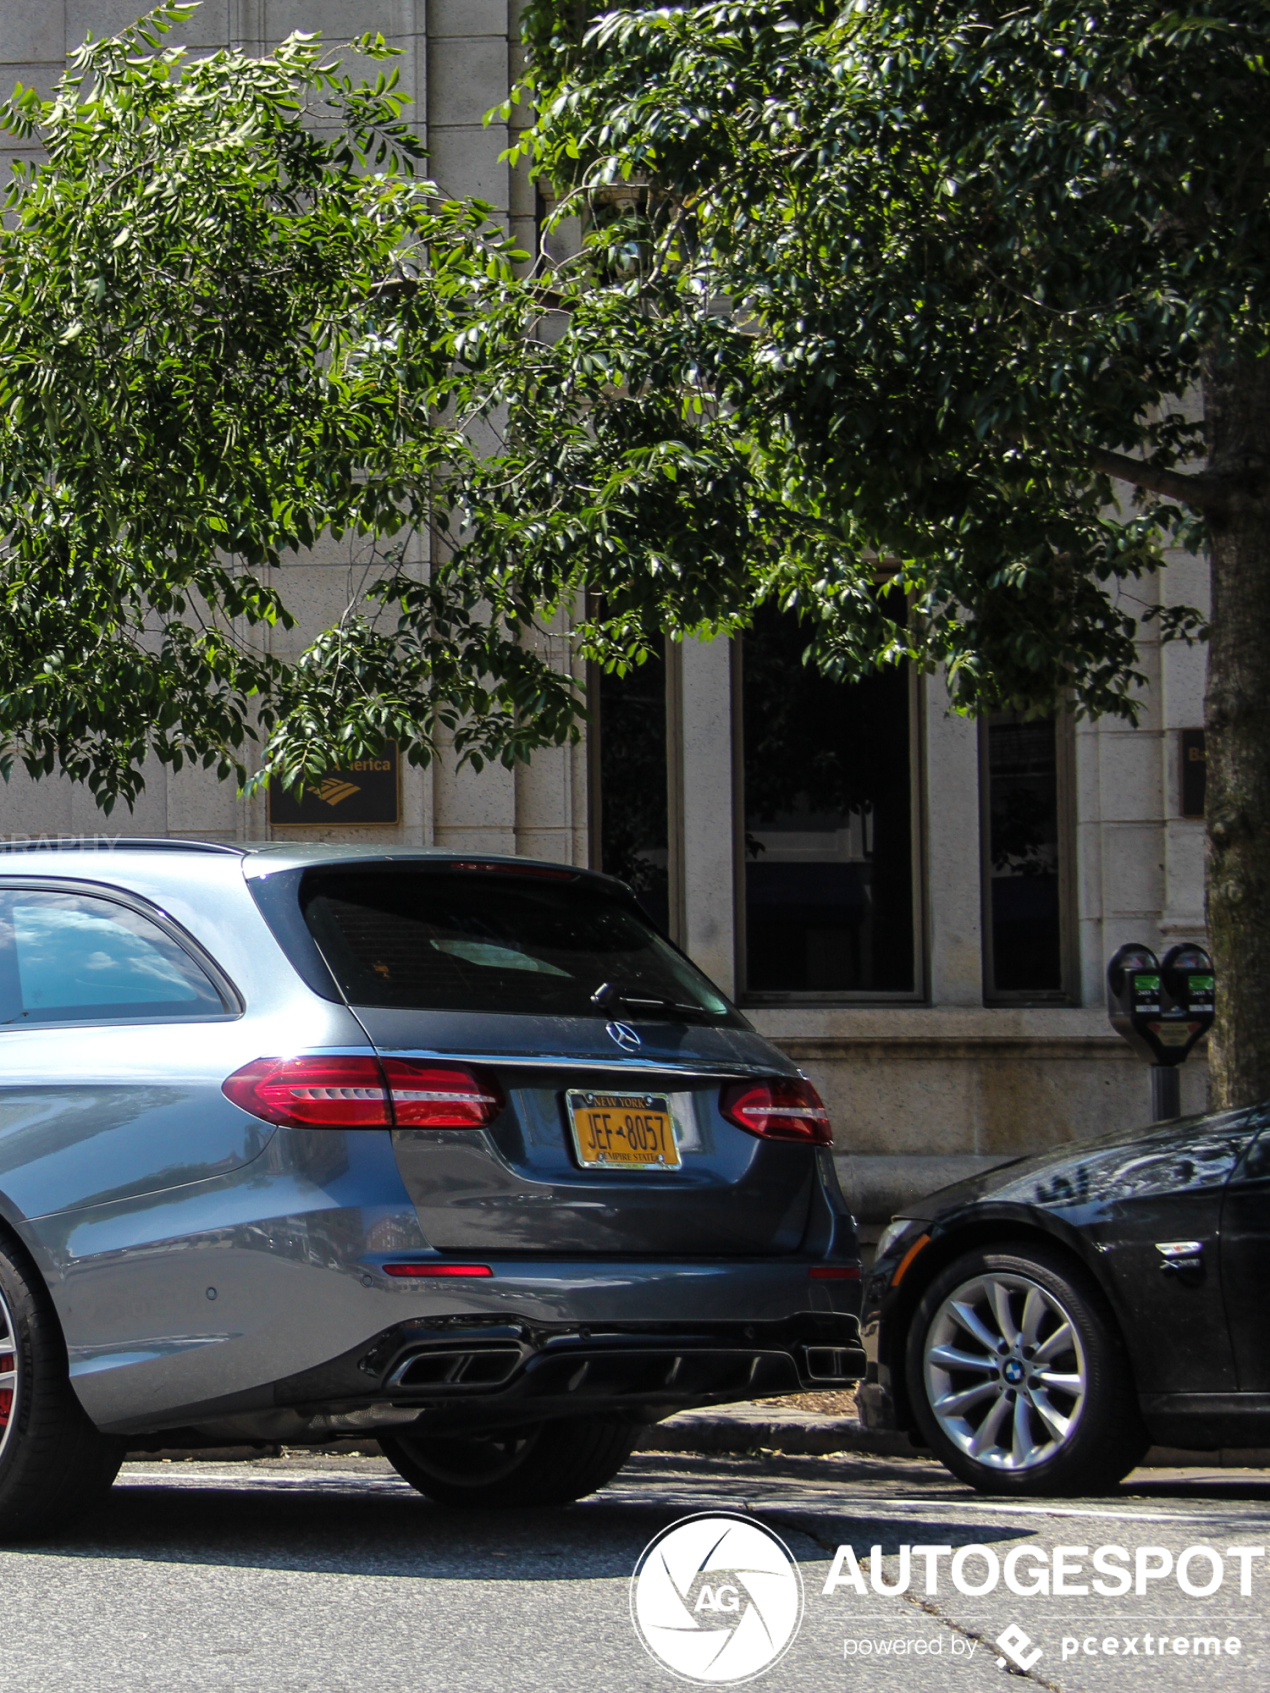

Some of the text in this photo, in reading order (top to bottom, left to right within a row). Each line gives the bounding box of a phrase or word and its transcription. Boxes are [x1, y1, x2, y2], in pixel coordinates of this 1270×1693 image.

[594, 1096, 646, 1109] NEW YORK
[603, 1151, 656, 1162] EMPIRE STATE
